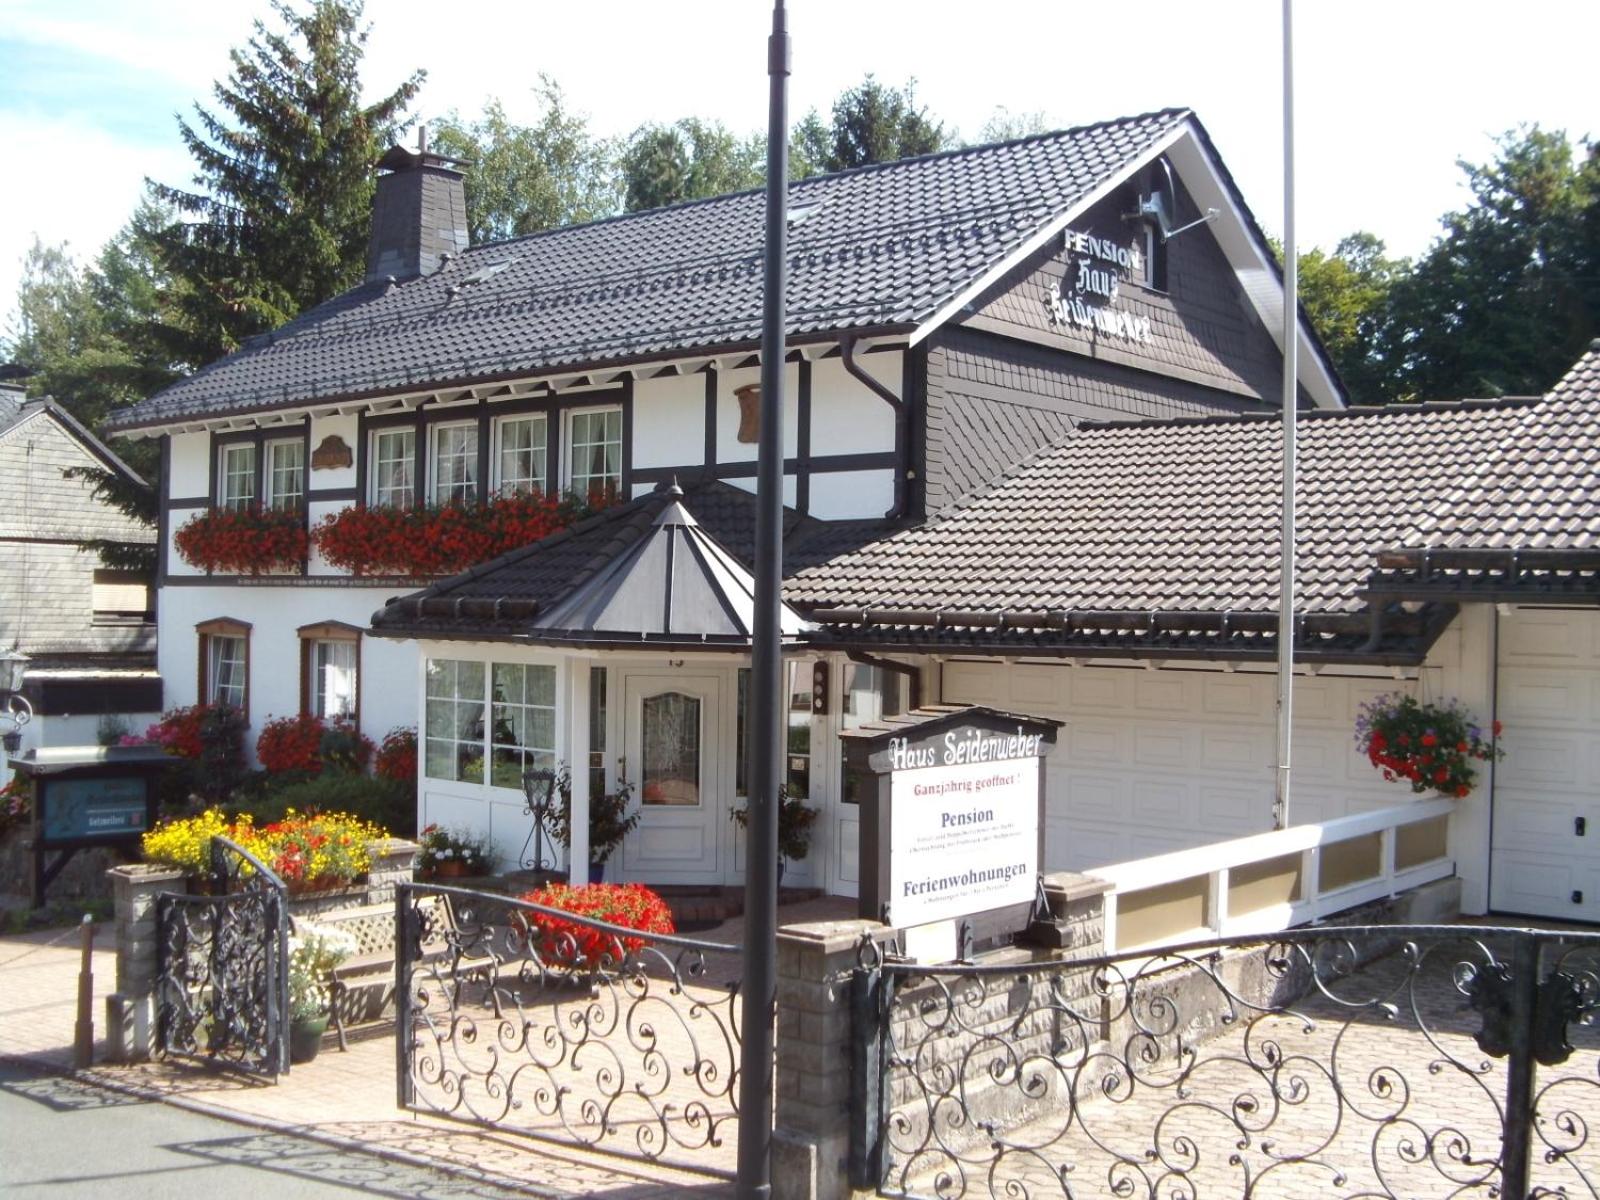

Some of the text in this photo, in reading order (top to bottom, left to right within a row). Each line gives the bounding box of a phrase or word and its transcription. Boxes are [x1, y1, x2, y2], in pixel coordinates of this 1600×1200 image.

[1064, 228, 1140, 269] PENSION
[1075, 259, 1118, 303] Haus
[888, 726, 1043, 769] Haus Seidenweber
[941, 808, 994, 828] Pension
[903, 863, 1027, 897] Ferienwohnungen
